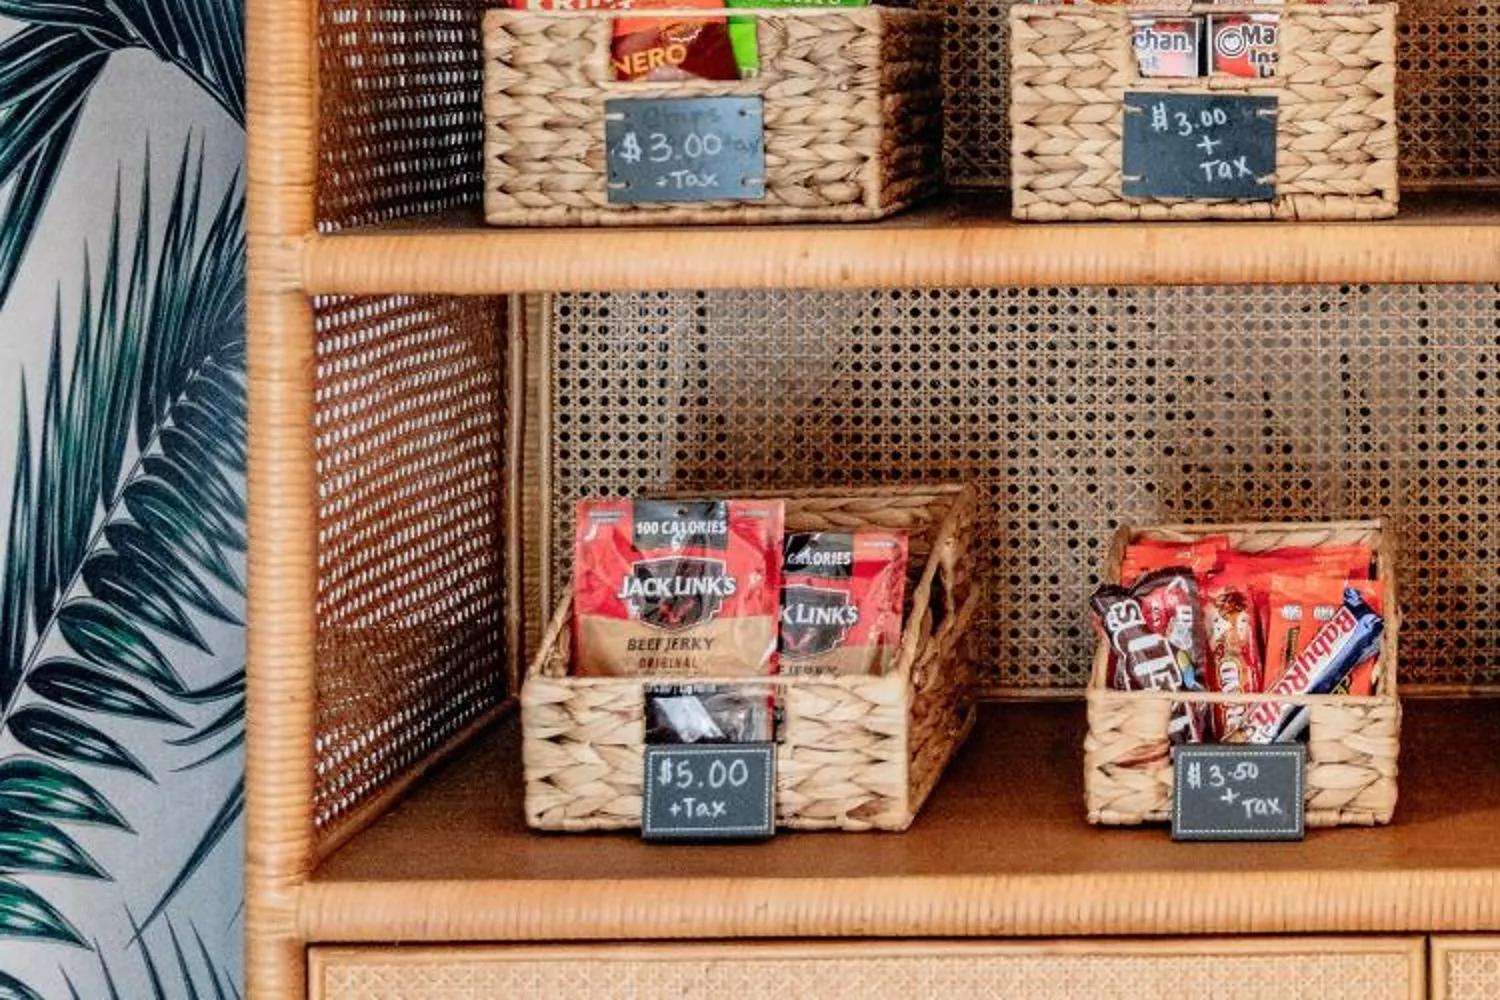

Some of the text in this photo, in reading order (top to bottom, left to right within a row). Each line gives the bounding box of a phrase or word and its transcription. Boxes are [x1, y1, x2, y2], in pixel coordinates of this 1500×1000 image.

[621, 132, 722, 163] $3.00
[1200, 155, 1253, 182] Tax
[636, 520, 727, 535] 100 CALORIES
[617, 575, 674, 598] JACK
[627, 638, 714, 652] BEEF JERKY
[657, 757, 748, 788] $5.00
